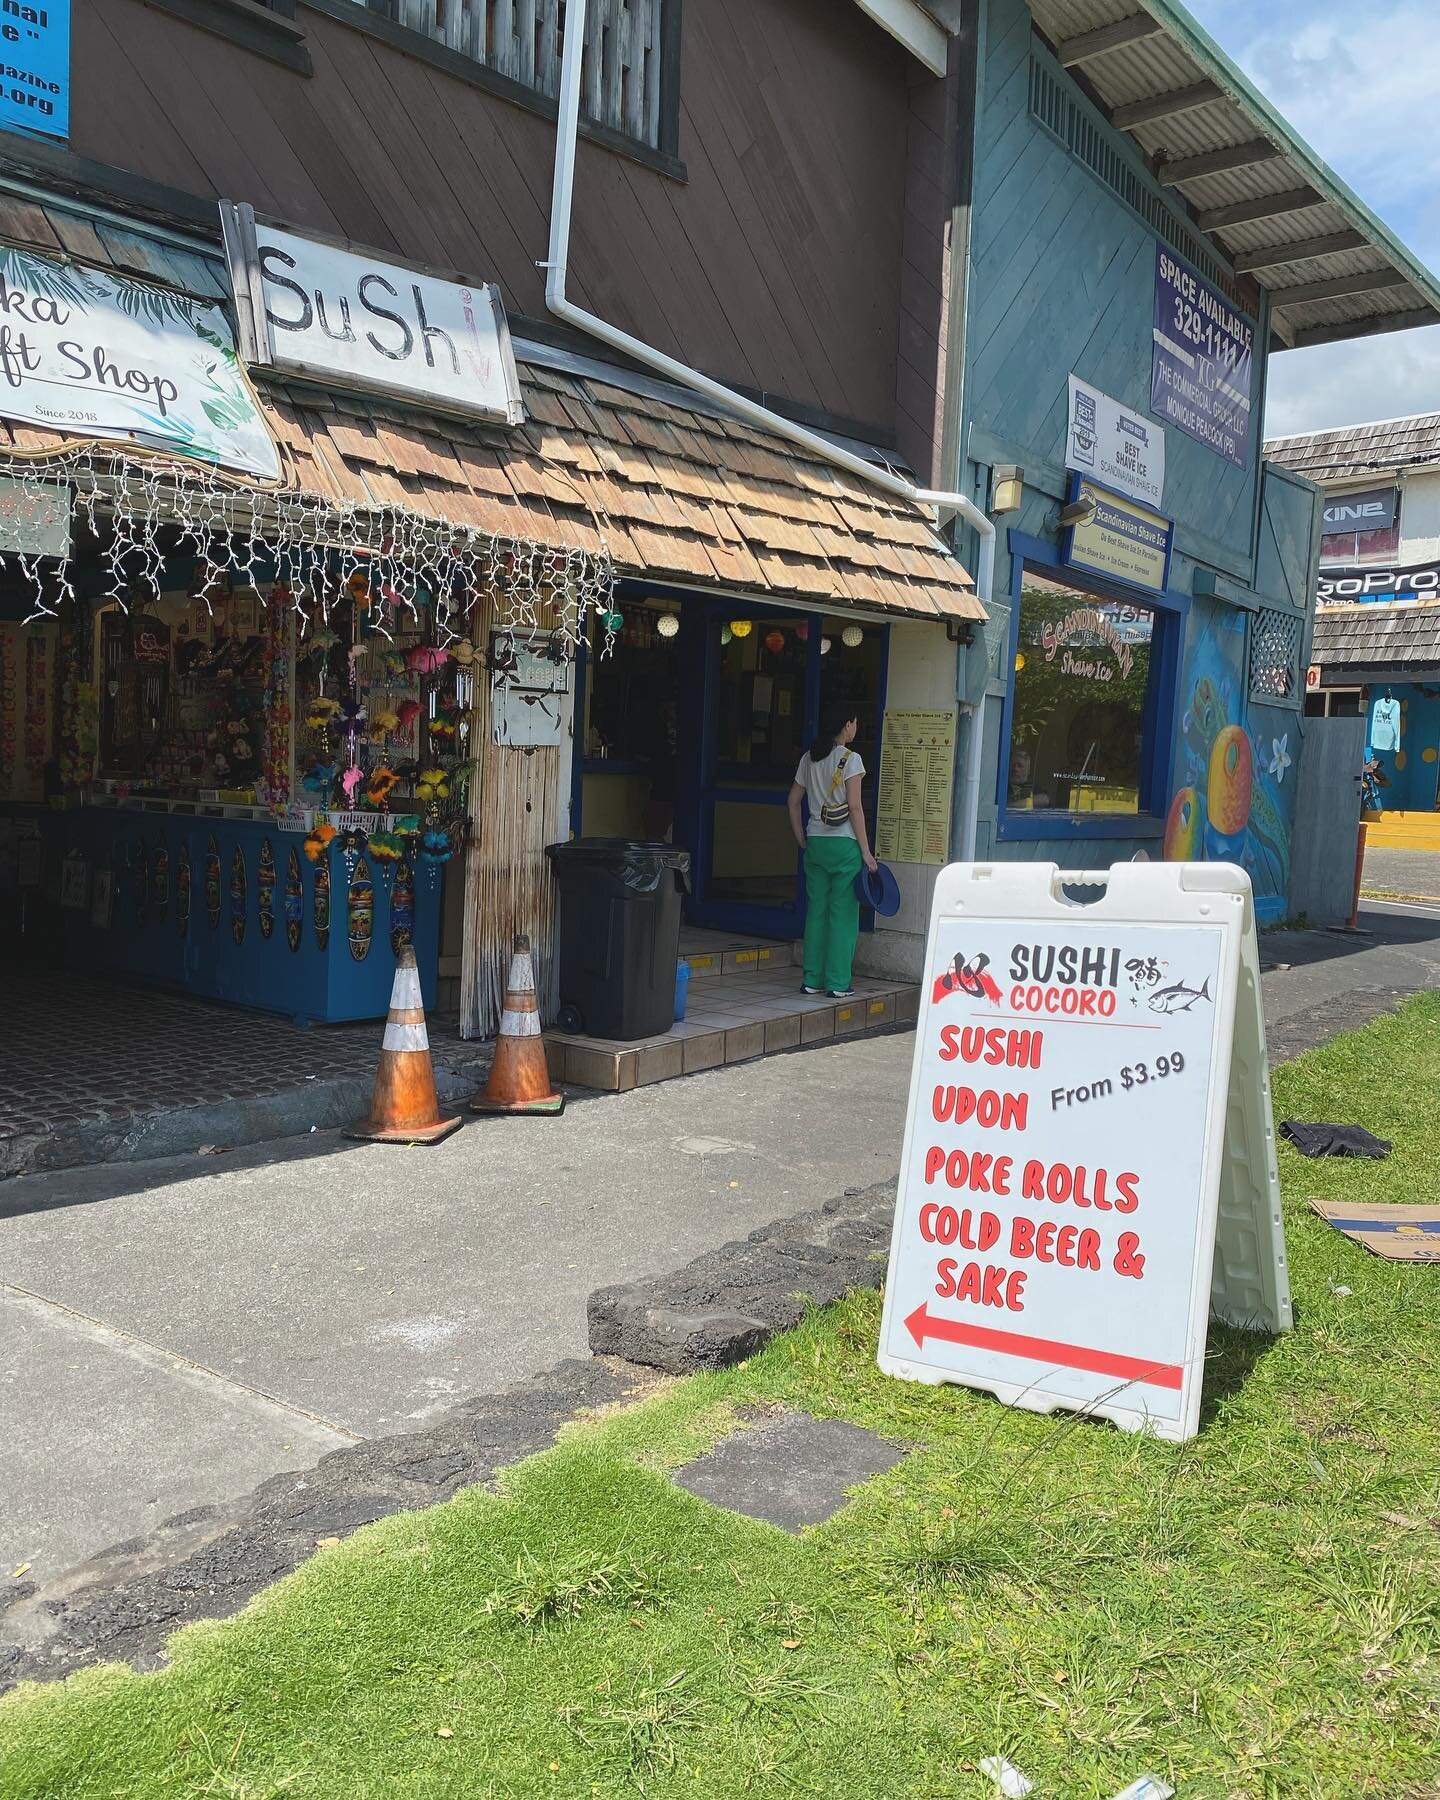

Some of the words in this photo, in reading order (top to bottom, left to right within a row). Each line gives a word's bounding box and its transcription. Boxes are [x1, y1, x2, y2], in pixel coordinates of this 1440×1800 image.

[1159, 253, 1197, 305] SPACE
[1198, 288, 1252, 351] AVAILABLE
[1173, 296, 1238, 374] 329-1111
[56, 341, 178, 417] Shop
[1159, 360, 1172, 386] THE
[1172, 371, 1212, 416] COMMERCIAL
[1233, 414, 1244, 437] LLC
[35, 404, 66, 420] Since
[67, 409, 98, 422] 2018
[1166, 395, 1195, 431] MONIQUE
[1195, 415, 1224, 449] PEACOCK
[1115, 451, 1136, 473] SHAVE
[1136, 462, 1147, 478] ICE
[1124, 441, 1140, 459] BEST
[1100, 459, 1136, 486] SCANDINAVIAN
[1135, 477, 1151, 494] SHAVE
[1150, 485, 1159, 497] ICE
[1096, 506, 1138, 536] Scandinavian
[1138, 525, 1157, 544] Shave
[1156, 533, 1166, 548] Ice
[1061, 650, 1096, 680] Shave
[1095, 659, 1113, 682] Ice
[1009, 943, 1122, 988] SUSHI
[1009, 984, 1117, 1017] COCORO
[938, 1024, 1044, 1070] SUSHI
[1050, 1077, 1113, 1111] From
[1120, 1051, 1186, 1091] $3.99
[932, 1084, 1029, 1131] UDON
[925, 1146, 1014, 1195] POKE
[1021, 1159, 1140, 1214] ROLLS
[919, 1202, 1001, 1252] COLD
[1009, 1216, 1102, 1271] BEER
[1113, 1231, 1146, 1280] &
[935, 1258, 1028, 1312] SAKE
